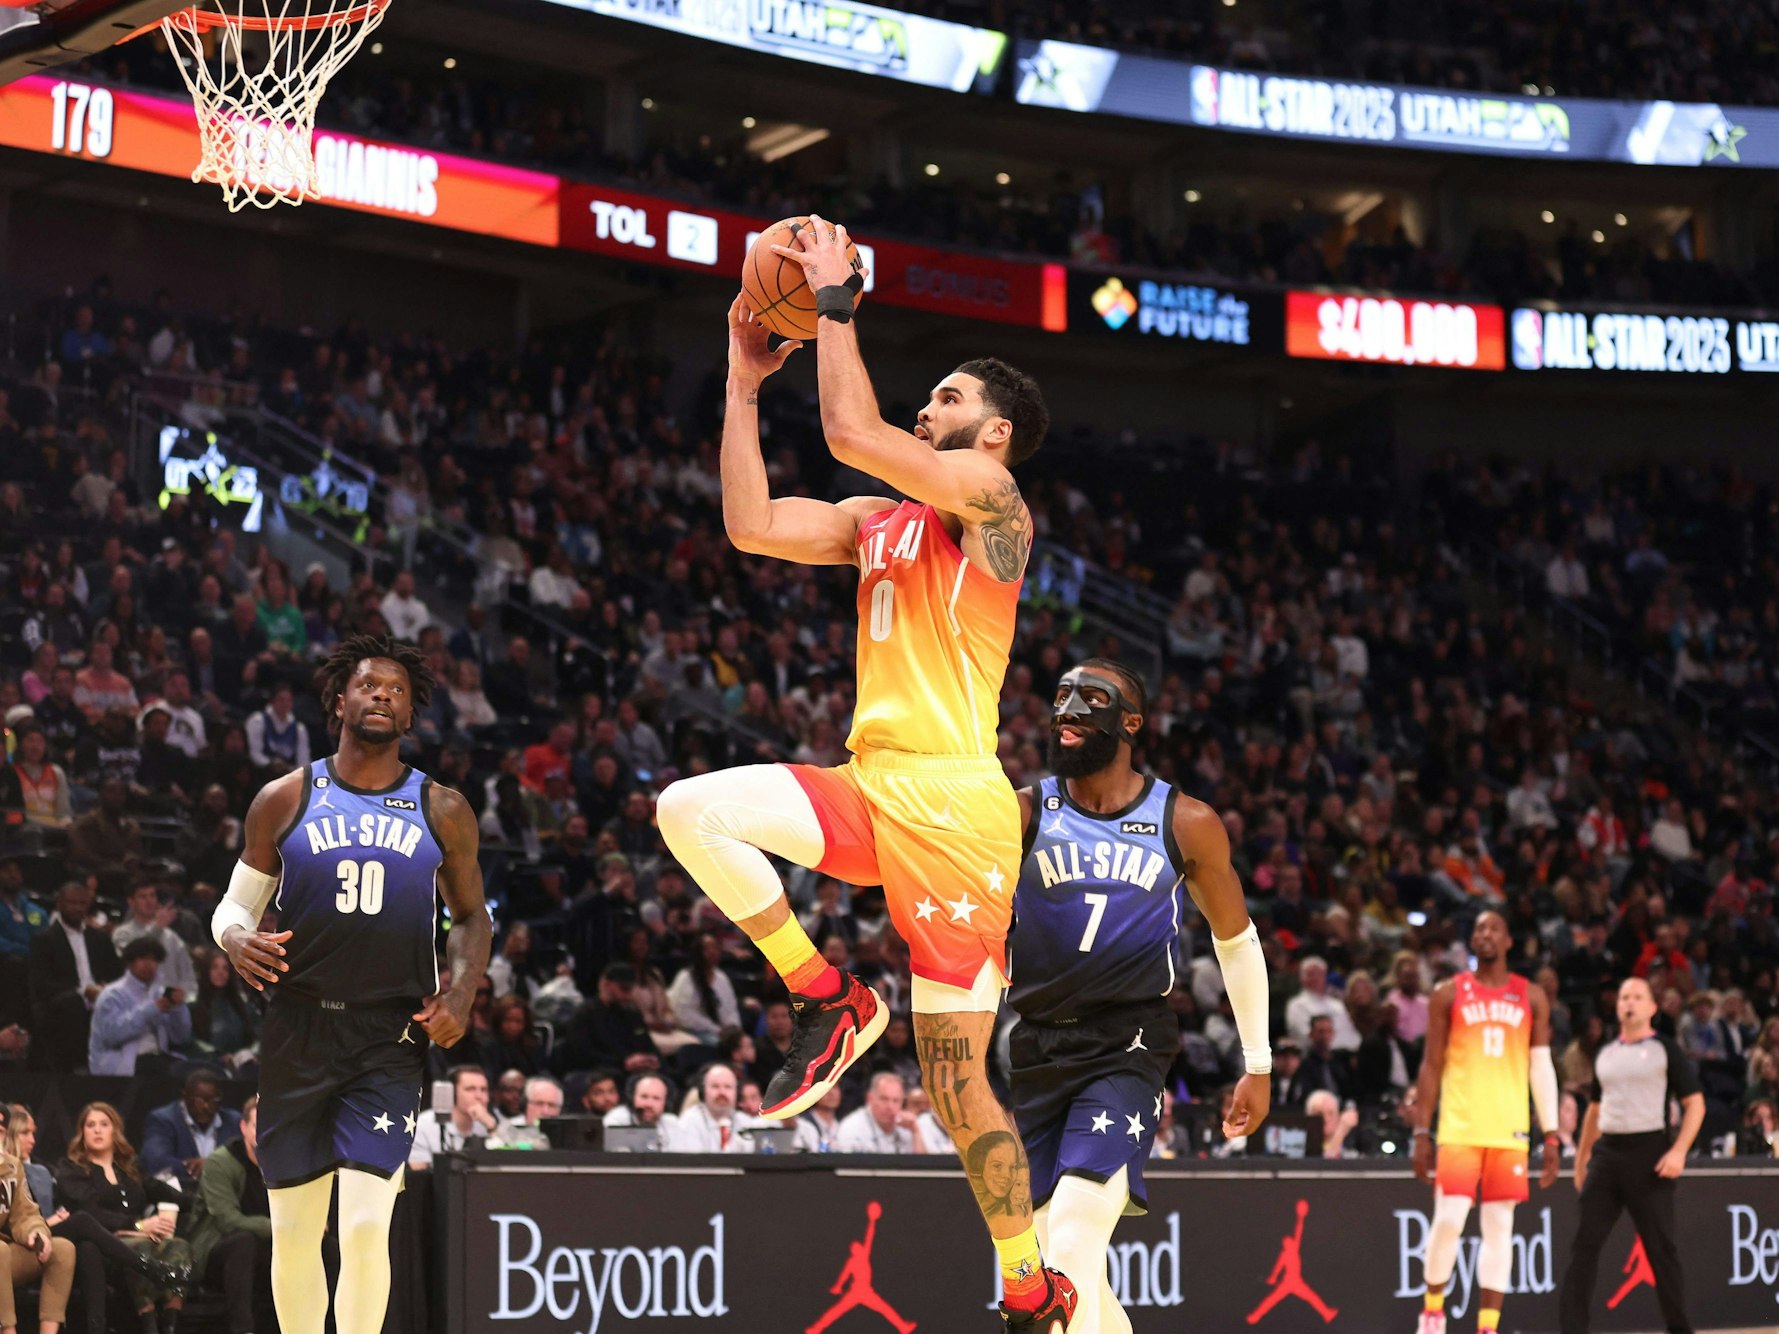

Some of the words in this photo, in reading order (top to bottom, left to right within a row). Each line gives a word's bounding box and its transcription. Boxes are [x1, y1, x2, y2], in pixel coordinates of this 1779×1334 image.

[751, 1, 827, 42] UTAH
[51, 81, 113, 157] 179
[1401, 93, 1481, 135] UTAH
[315, 136, 439, 217] GIANNIS
[589, 200, 656, 249] TOL
[905, 264, 1010, 307] BONUS
[1139, 306, 1250, 344] FUTURE
[1318, 298, 1478, 366] $400,000
[869, 580, 895, 642] 0
[316, 777, 328, 788] 6
[1047, 797, 1060, 810] 6
[304, 814, 423, 859] ALL-STAR
[335, 859, 386, 916] 30
[1034, 841, 1166, 893] ALL-STAR
[1079, 892, 1108, 953] 7
[1461, 1000, 1525, 1029] ALL-STAR
[1482, 1026, 1505, 1057] 13
[489, 1212, 729, 1334] Beyond
[1393, 1206, 1556, 1319] Bynd
[1727, 1204, 1779, 1304] Be
